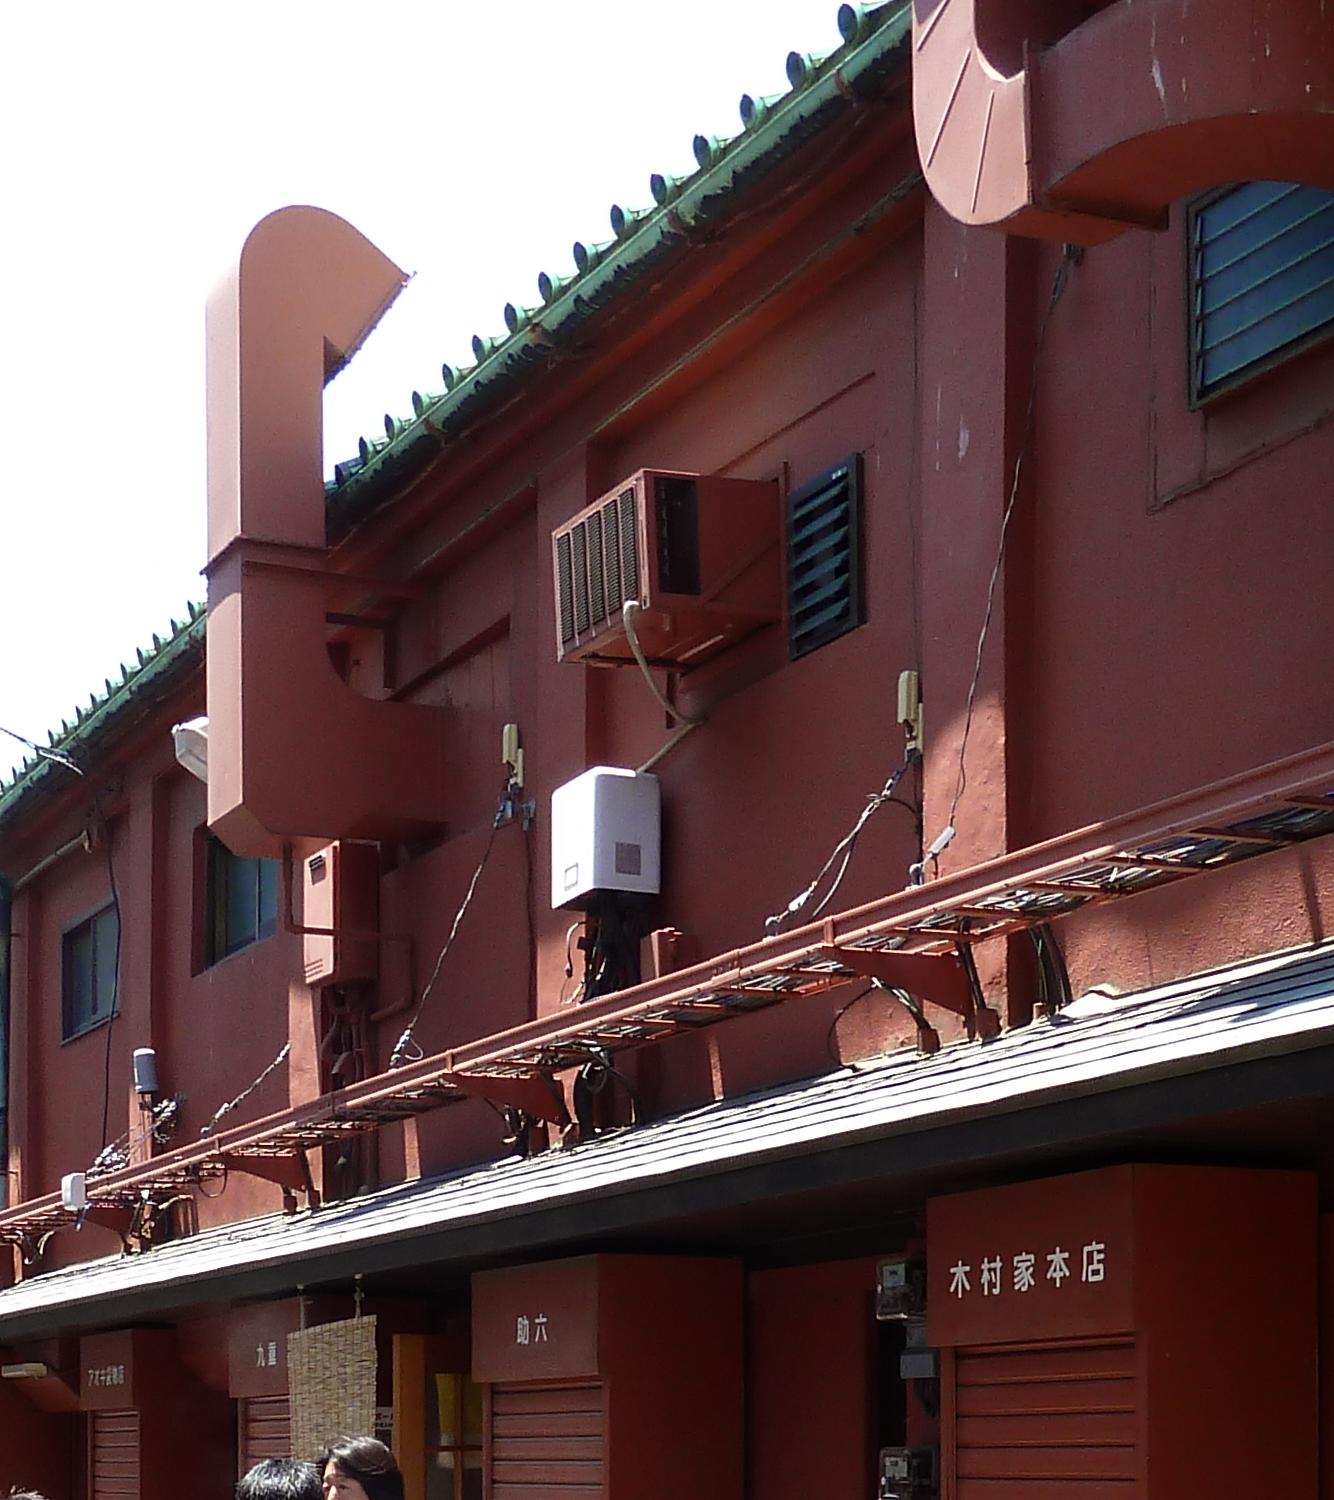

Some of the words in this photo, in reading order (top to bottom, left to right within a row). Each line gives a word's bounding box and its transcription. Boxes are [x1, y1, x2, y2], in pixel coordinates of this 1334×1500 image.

[948, 1240, 1106, 1299] 木村家本店
[516, 1312, 548, 1346] 助六
